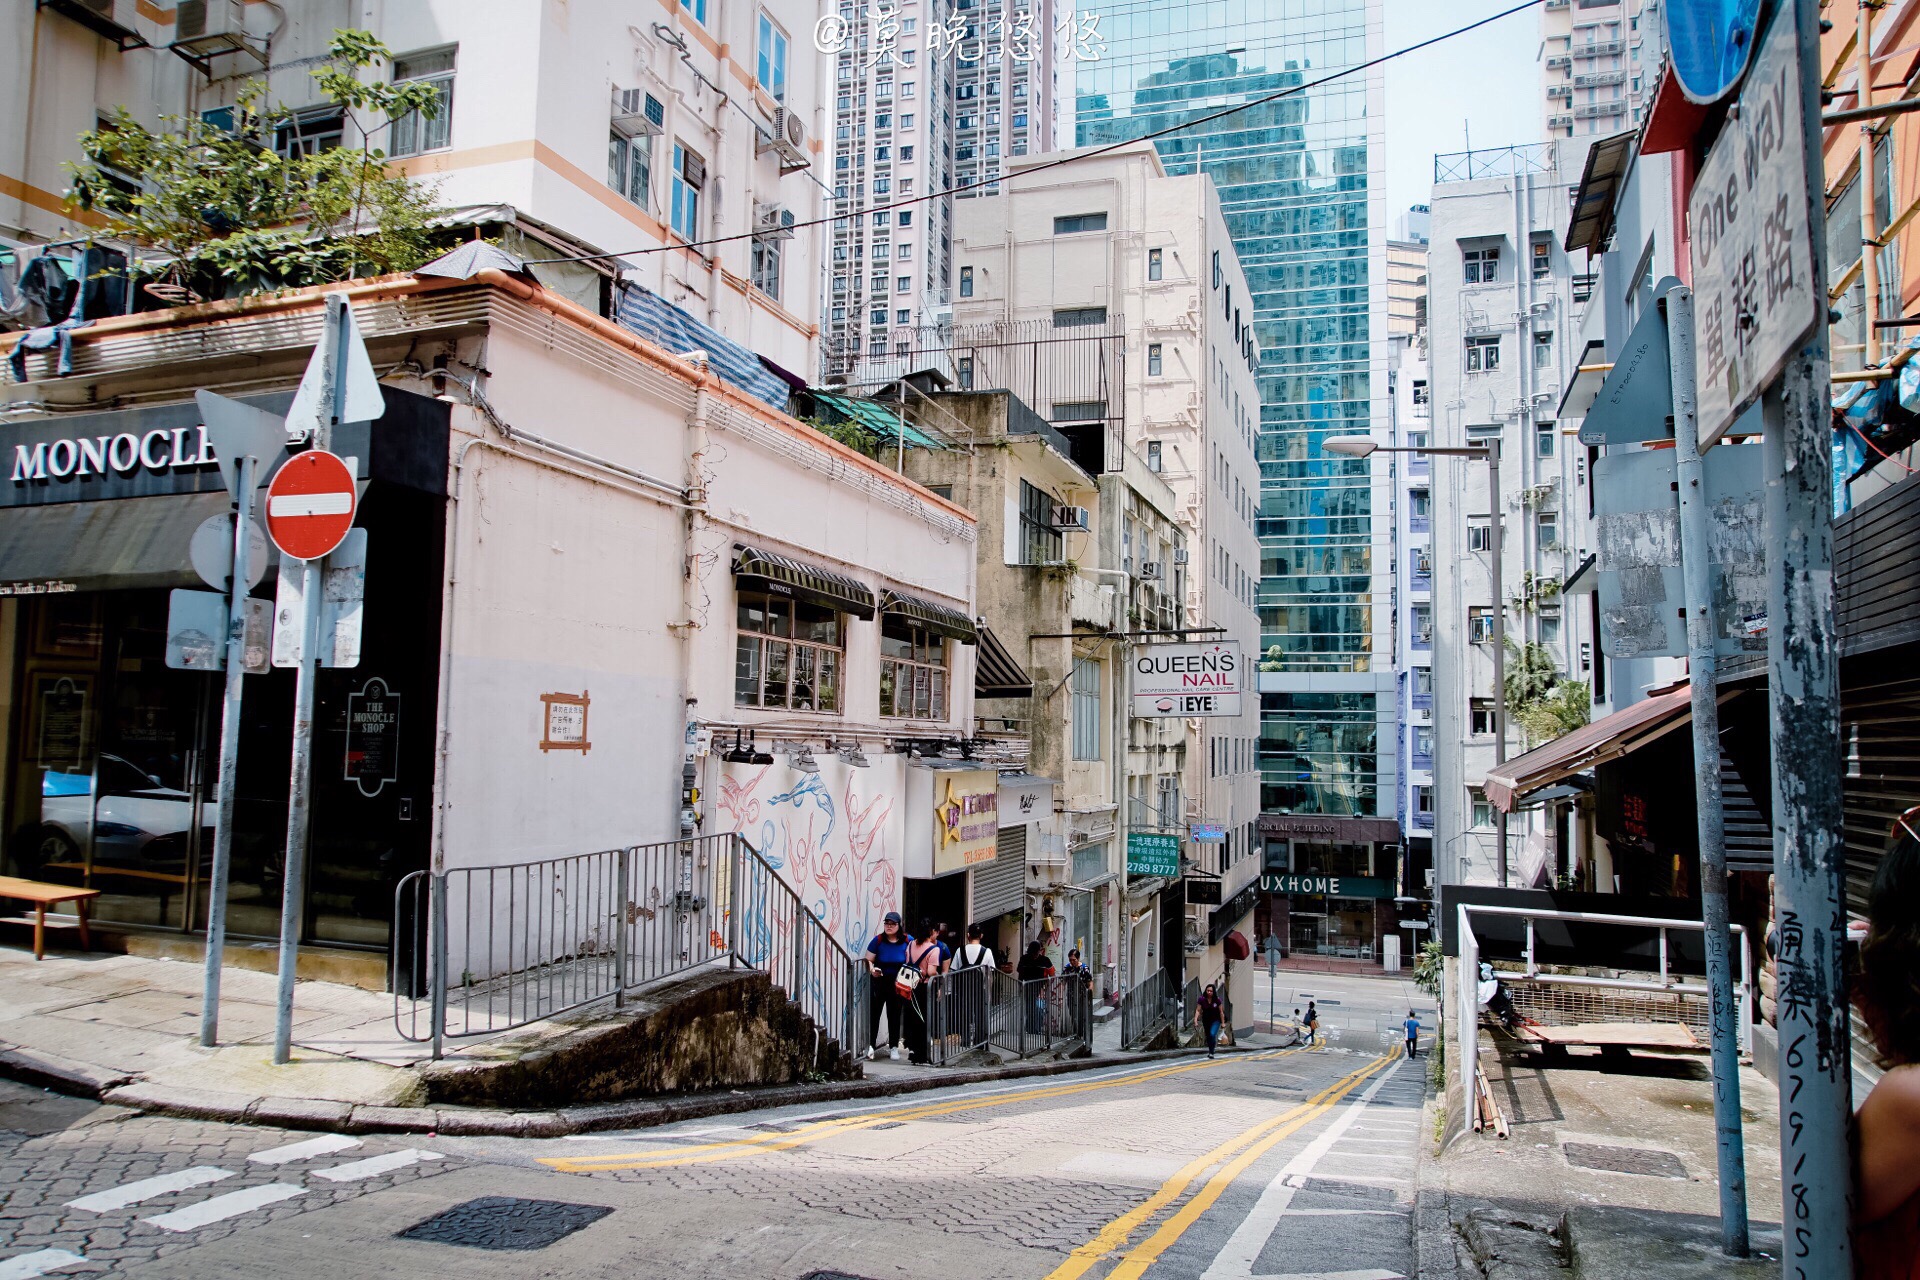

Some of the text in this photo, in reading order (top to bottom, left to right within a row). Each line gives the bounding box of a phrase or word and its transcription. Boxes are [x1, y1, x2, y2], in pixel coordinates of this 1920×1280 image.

[1700, 64, 1787, 268] One Way
[1704, 193, 1793, 389] 單程路
[10, 424, 219, 481] MONOCLE
[1182, 673, 1234, 686] NAIL
[366, 702, 384, 712] THE
[1186, 696, 1212, 712] EYE
[353, 712, 395, 723] MONOCLE
[362, 723, 385, 733] SHOP
[1293, 824, 1335, 833] BUILDING
[1127, 862, 1176, 875] 2789 8777
[1260, 875, 1340, 894] UXHOME
